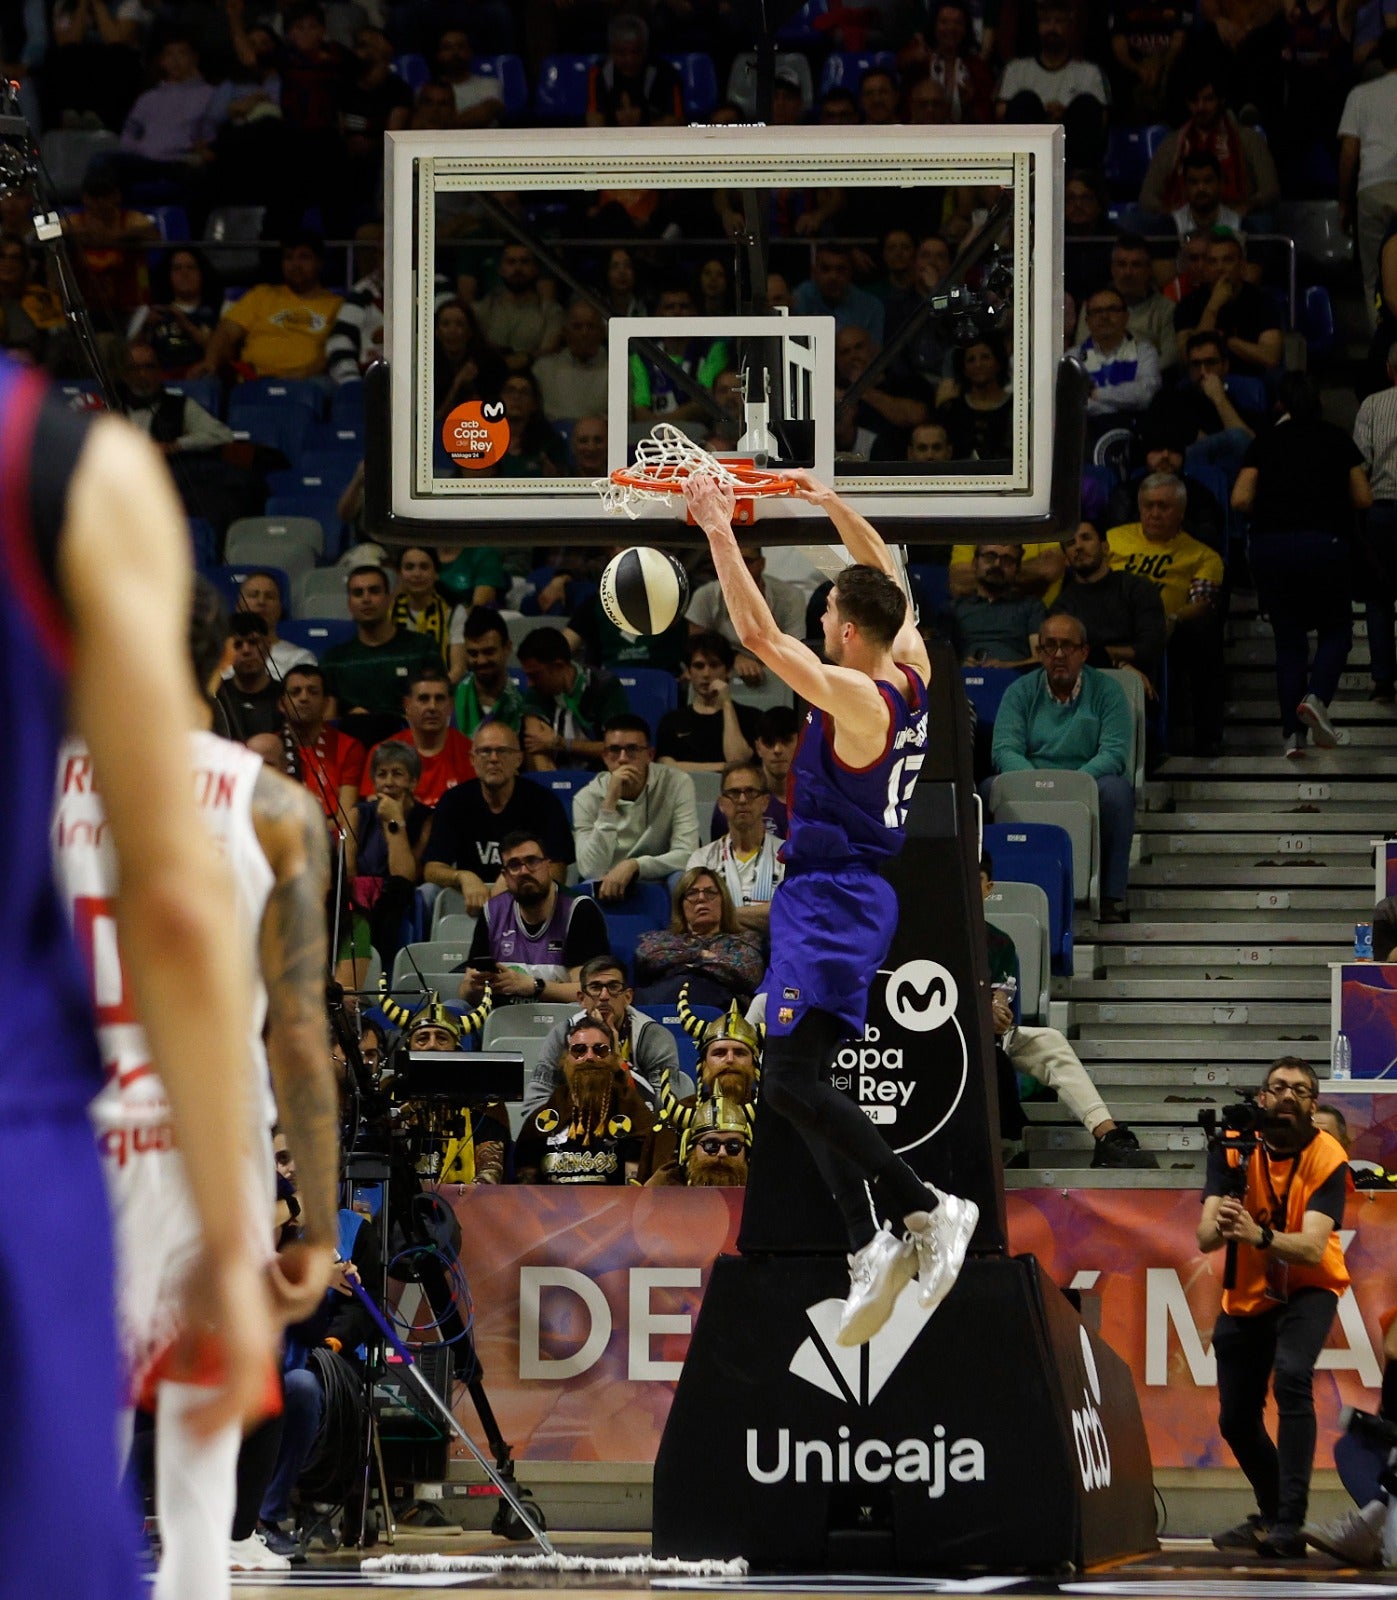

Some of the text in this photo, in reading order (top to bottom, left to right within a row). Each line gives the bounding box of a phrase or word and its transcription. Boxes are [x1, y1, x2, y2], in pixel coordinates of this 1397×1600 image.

[454, 428, 487, 439] Copa
[470, 440, 492, 452] Rey
[1307, 786, 1324, 797] 11
[1285, 839, 1304, 850] 10
[1269, 895, 1278, 906] 9
[1250, 951, 1260, 962] 8
[1226, 1010, 1236, 1020] 7
[831, 1048, 904, 1074] opa
[1207, 1071, 1216, 1082] 6
[858, 1075, 917, 1106] Rey
[1181, 1136, 1190, 1147] 5
[519, 1266, 702, 1381] DE
[1071, 1387, 1112, 1493] acb
[746, 1424, 986, 1499] Unicaja
